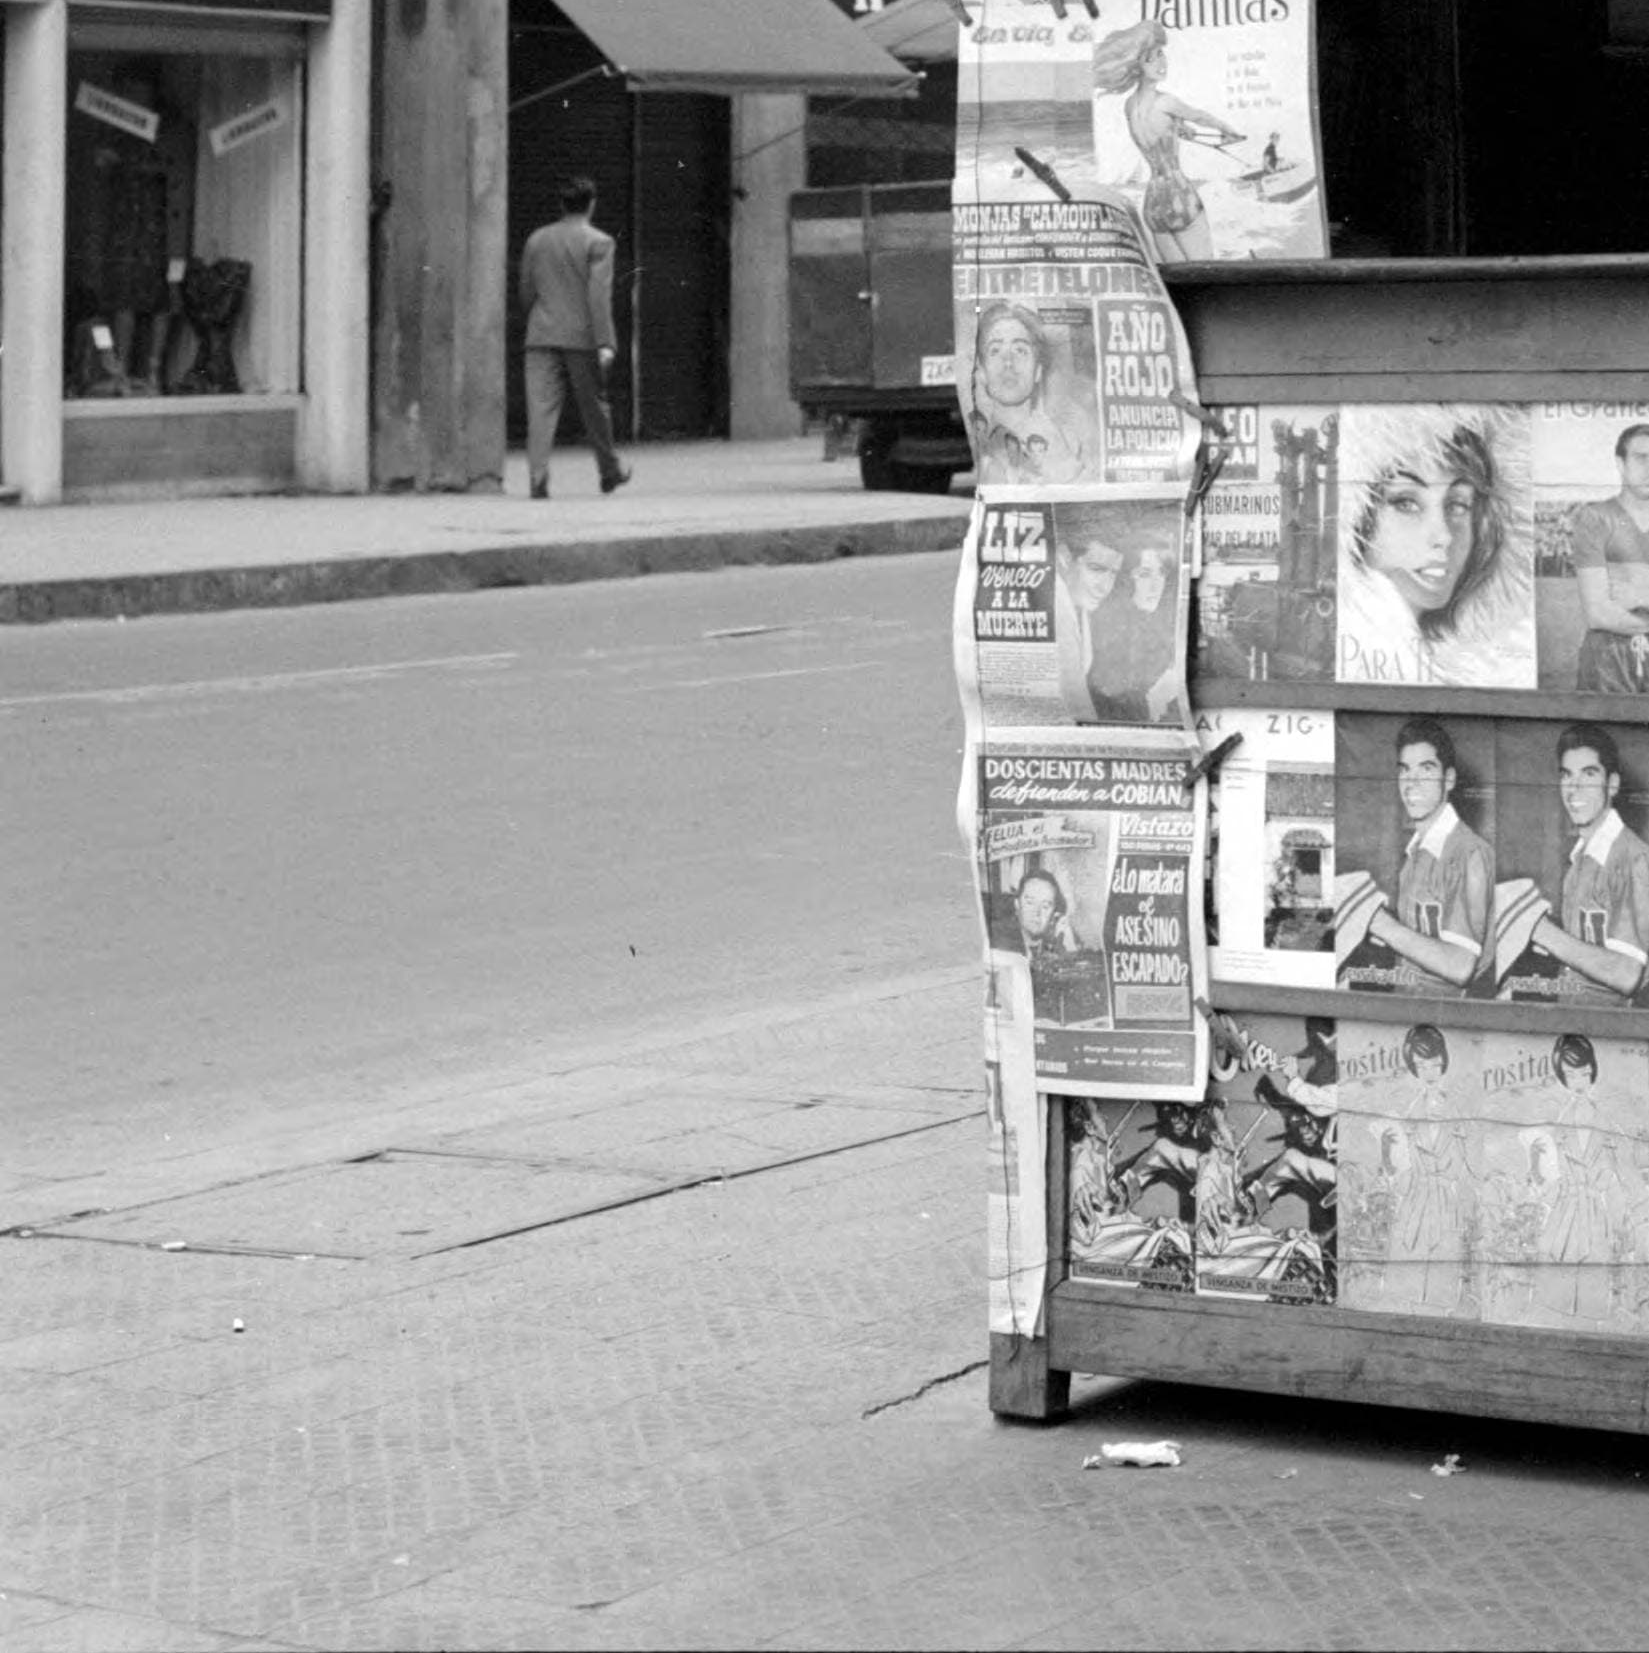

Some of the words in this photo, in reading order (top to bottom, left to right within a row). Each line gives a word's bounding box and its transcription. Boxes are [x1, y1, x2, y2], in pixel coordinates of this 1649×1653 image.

[953, 205, 1020, 233] MONJAS
[1106, 304, 1167, 352] AÑO
[1104, 354, 1175, 397] ROJO
[980, 510, 1047, 562] LIZ
[991, 591, 1003, 608] A
[1007, 591, 1030, 608] LA
[976, 611, 1049, 638] MUERTE
[985, 758, 1106, 782] DOSCIENTAS
[1110, 759, 1187, 782] MADRES
[989, 779, 1090, 807] defienden
[1119, 812, 1193, 838] Vistazo
[1114, 916, 1179, 948] ASESINO
[1111, 952, 1188, 984] ESCAPADO?
[1482, 1049, 1556, 1091] rosita
